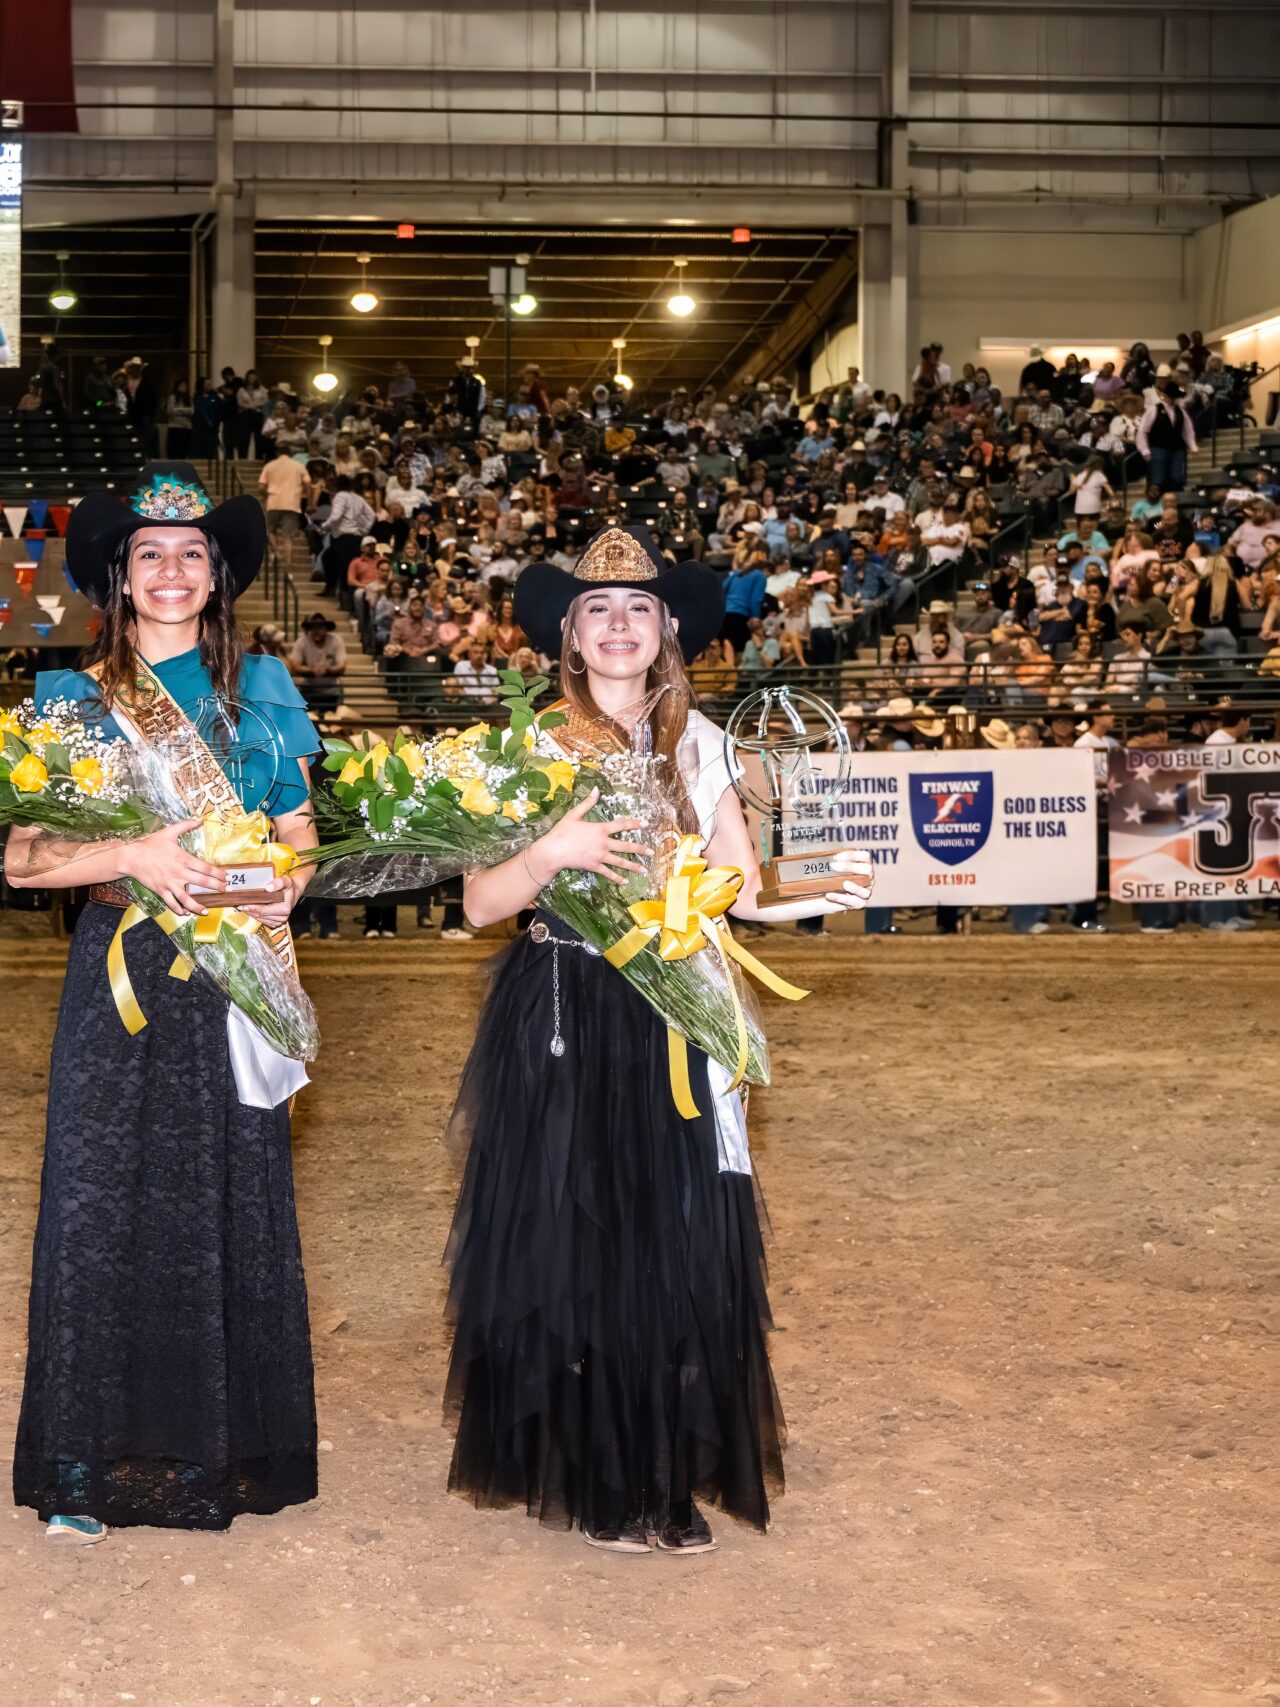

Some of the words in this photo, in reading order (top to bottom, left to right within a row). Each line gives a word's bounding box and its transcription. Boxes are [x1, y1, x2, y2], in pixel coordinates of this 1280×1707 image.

[1129, 751, 1214, 768] DOUBLE
[1222, 749, 1232, 766] J
[922, 781, 981, 794] FINWAY
[881, 801, 899, 817] OF
[1004, 798, 1035, 814] GOD
[1040, 796, 1087, 813] BLESS
[923, 823, 981, 834] ELECTRIC
[1004, 821, 1032, 838] THE
[1035, 820, 1067, 838] USA
[804, 862, 832, 875] 2024
[1122, 882, 1165, 898] SITE
[1175, 880, 1226, 897] PREP
[1234, 878, 1248, 895] &
